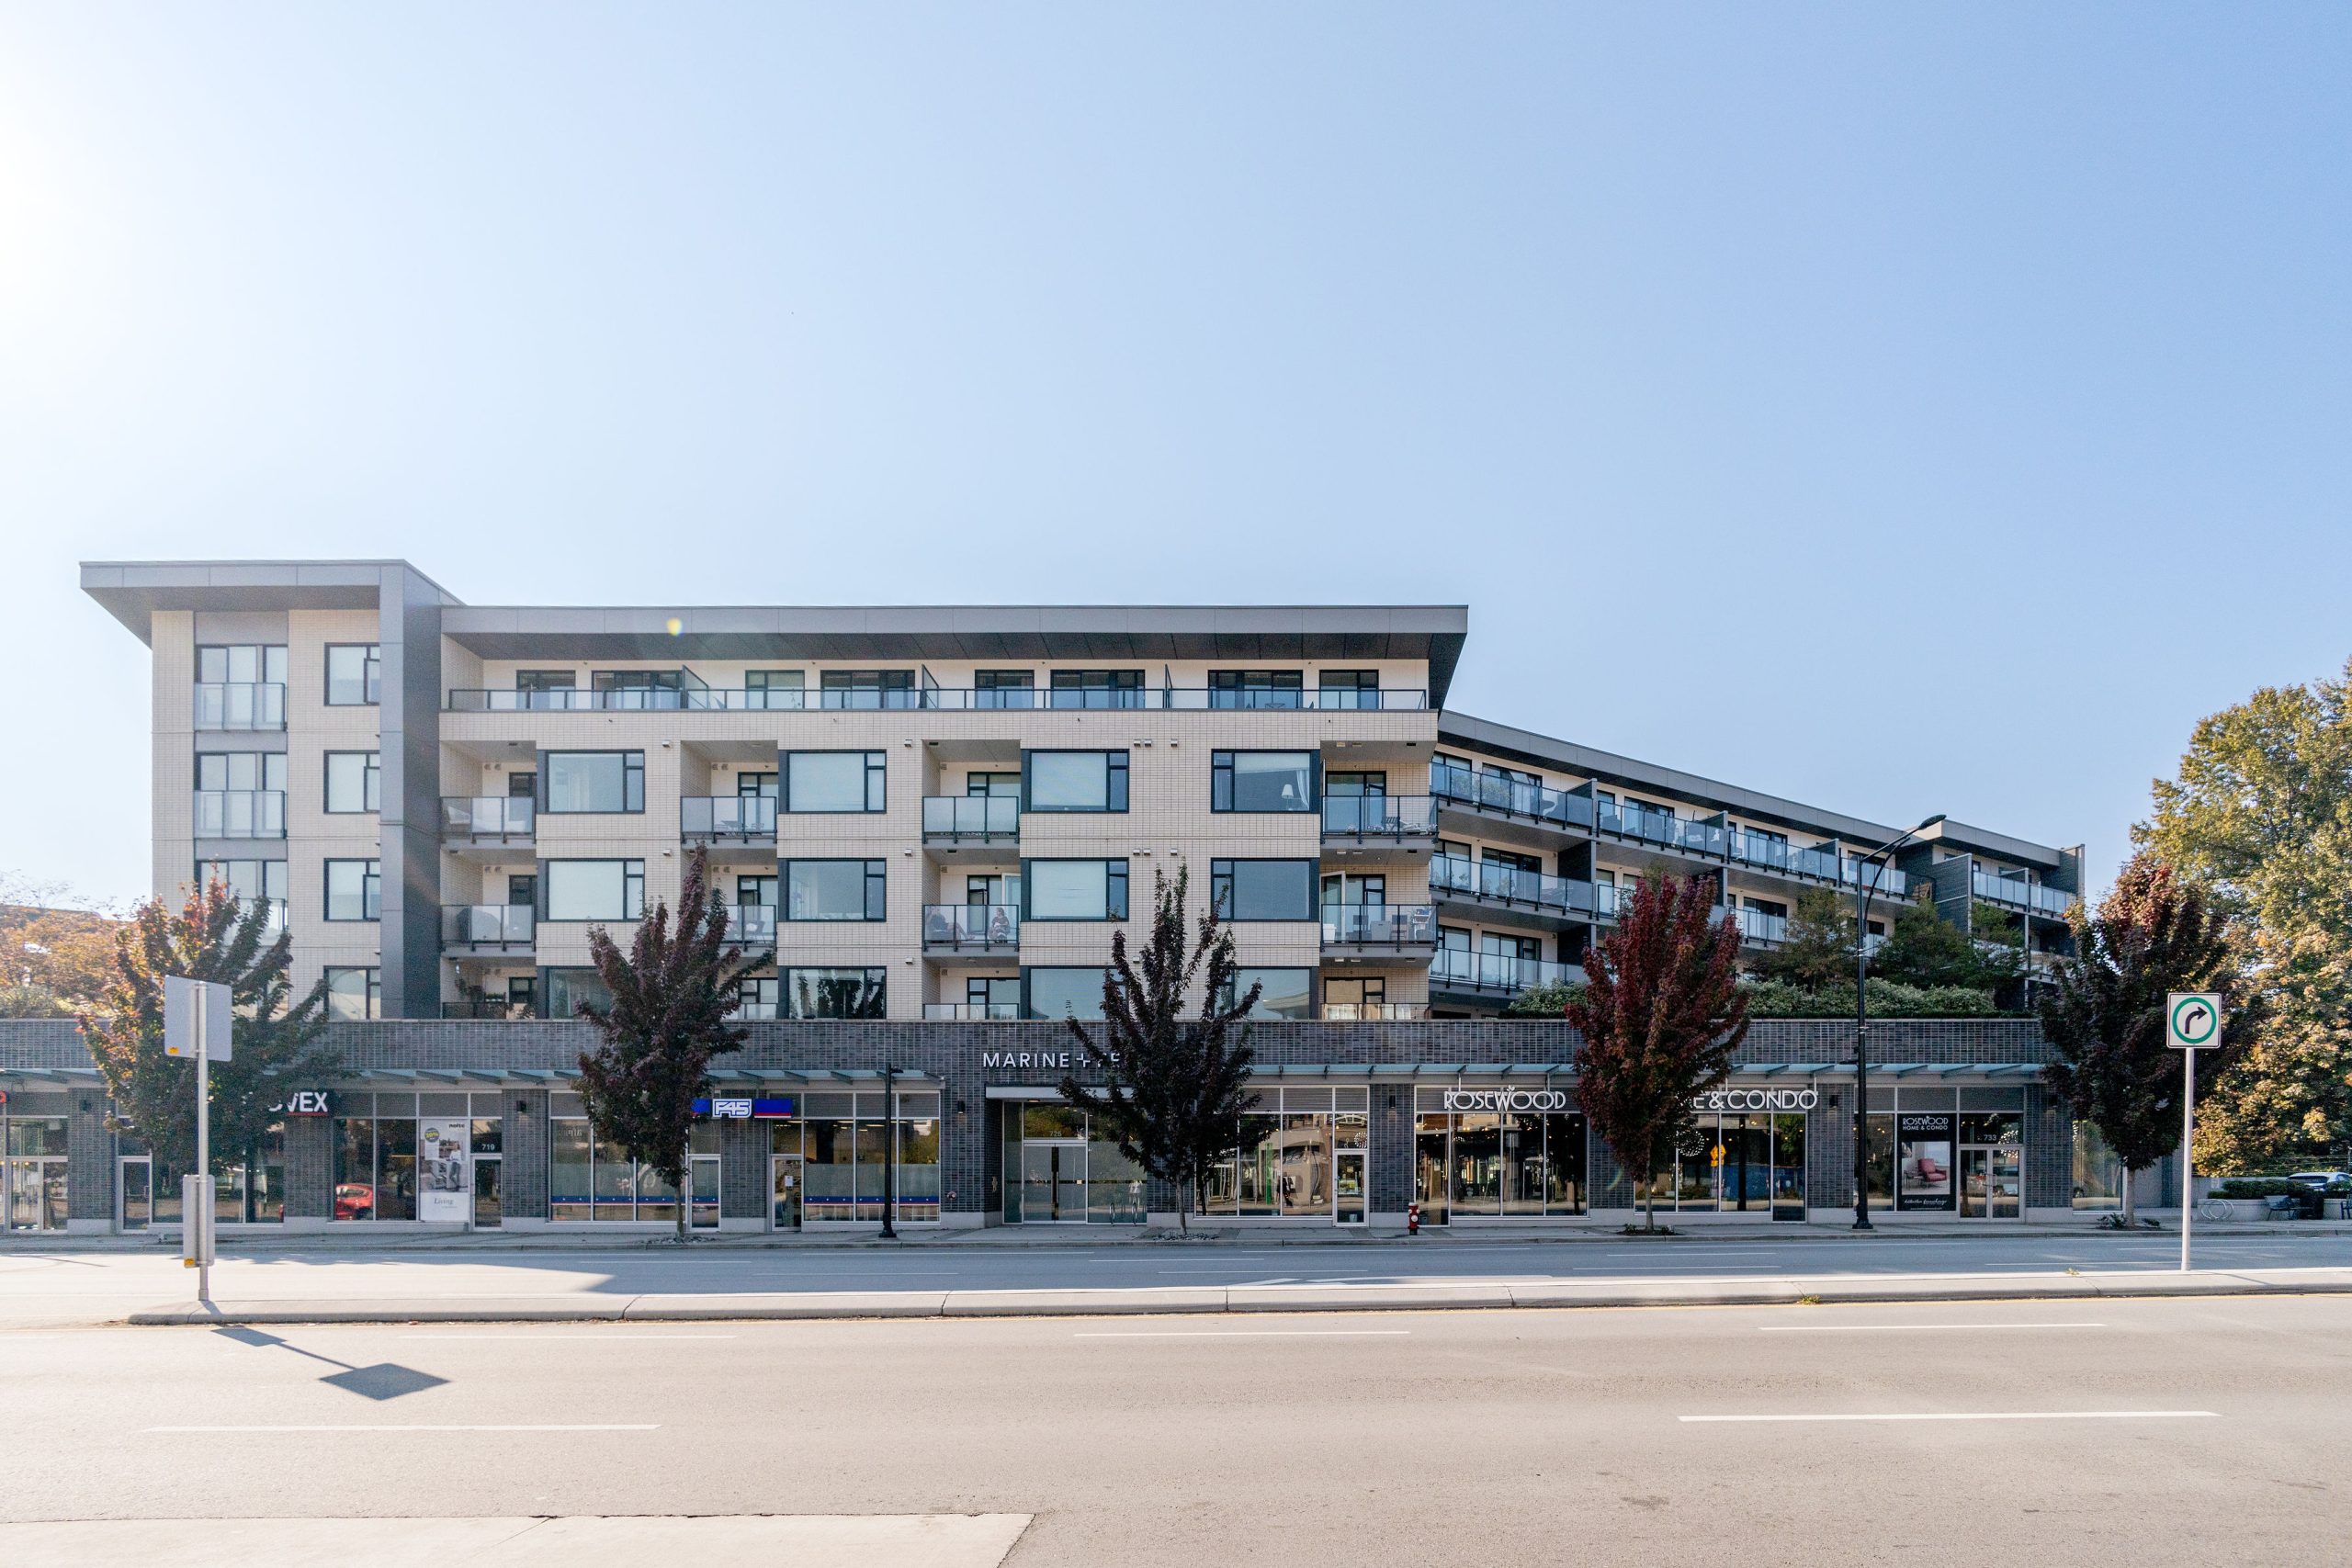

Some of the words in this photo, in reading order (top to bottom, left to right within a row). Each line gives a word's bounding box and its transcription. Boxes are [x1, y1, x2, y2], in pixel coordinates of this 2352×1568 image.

[983, 1053, 1069, 1068] MARINE
[1443, 1089, 1566, 1112] ROSEWOOD
[713, 1099, 752, 1118] F45
[1903, 1116, 1949, 1125] ROSEWOOD
[1984, 1134, 1997, 1142] 733
